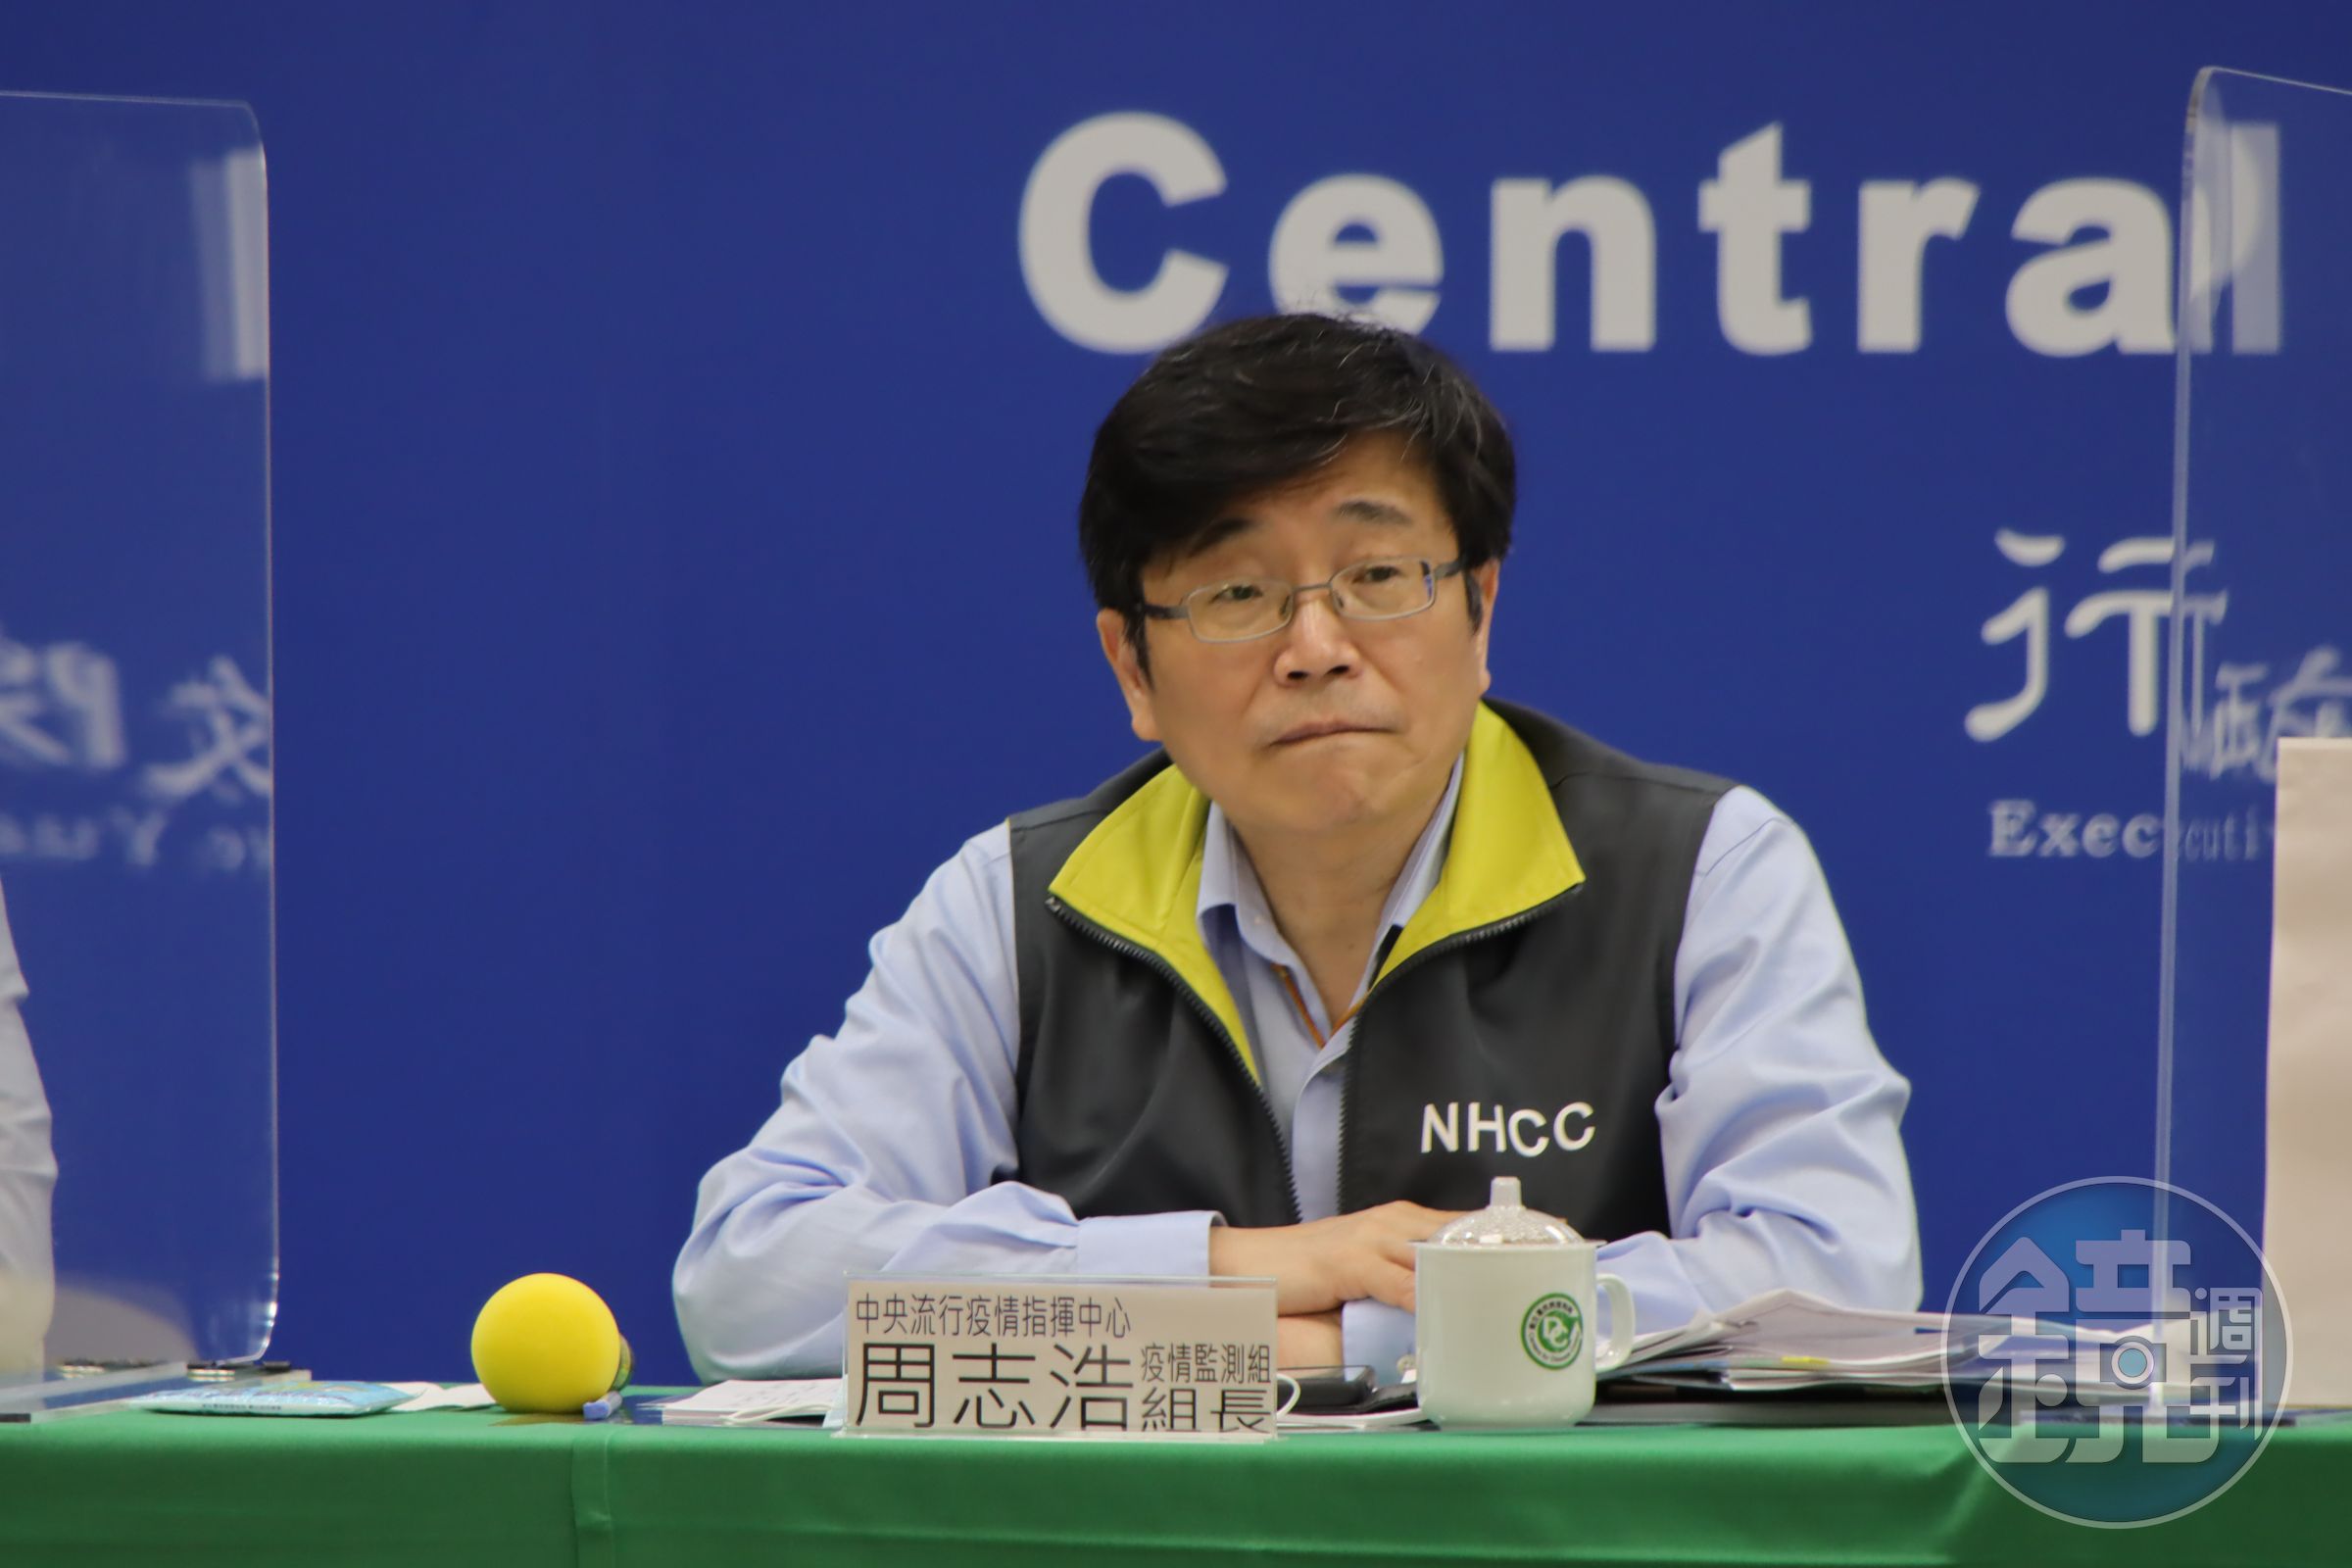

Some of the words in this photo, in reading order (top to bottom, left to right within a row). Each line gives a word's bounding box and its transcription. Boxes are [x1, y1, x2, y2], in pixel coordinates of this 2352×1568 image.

[1018, 110, 2282, 357] Central
[1420, 1101, 1596, 1158] NHCC
[855, 1292, 1132, 1339] 中央流行疫情指揮中心
[855, 1342, 1134, 1432] 周志浩
[1140, 1341, 1272, 1385] 疫情監測組
[1140, 1387, 1273, 1434] 組長
